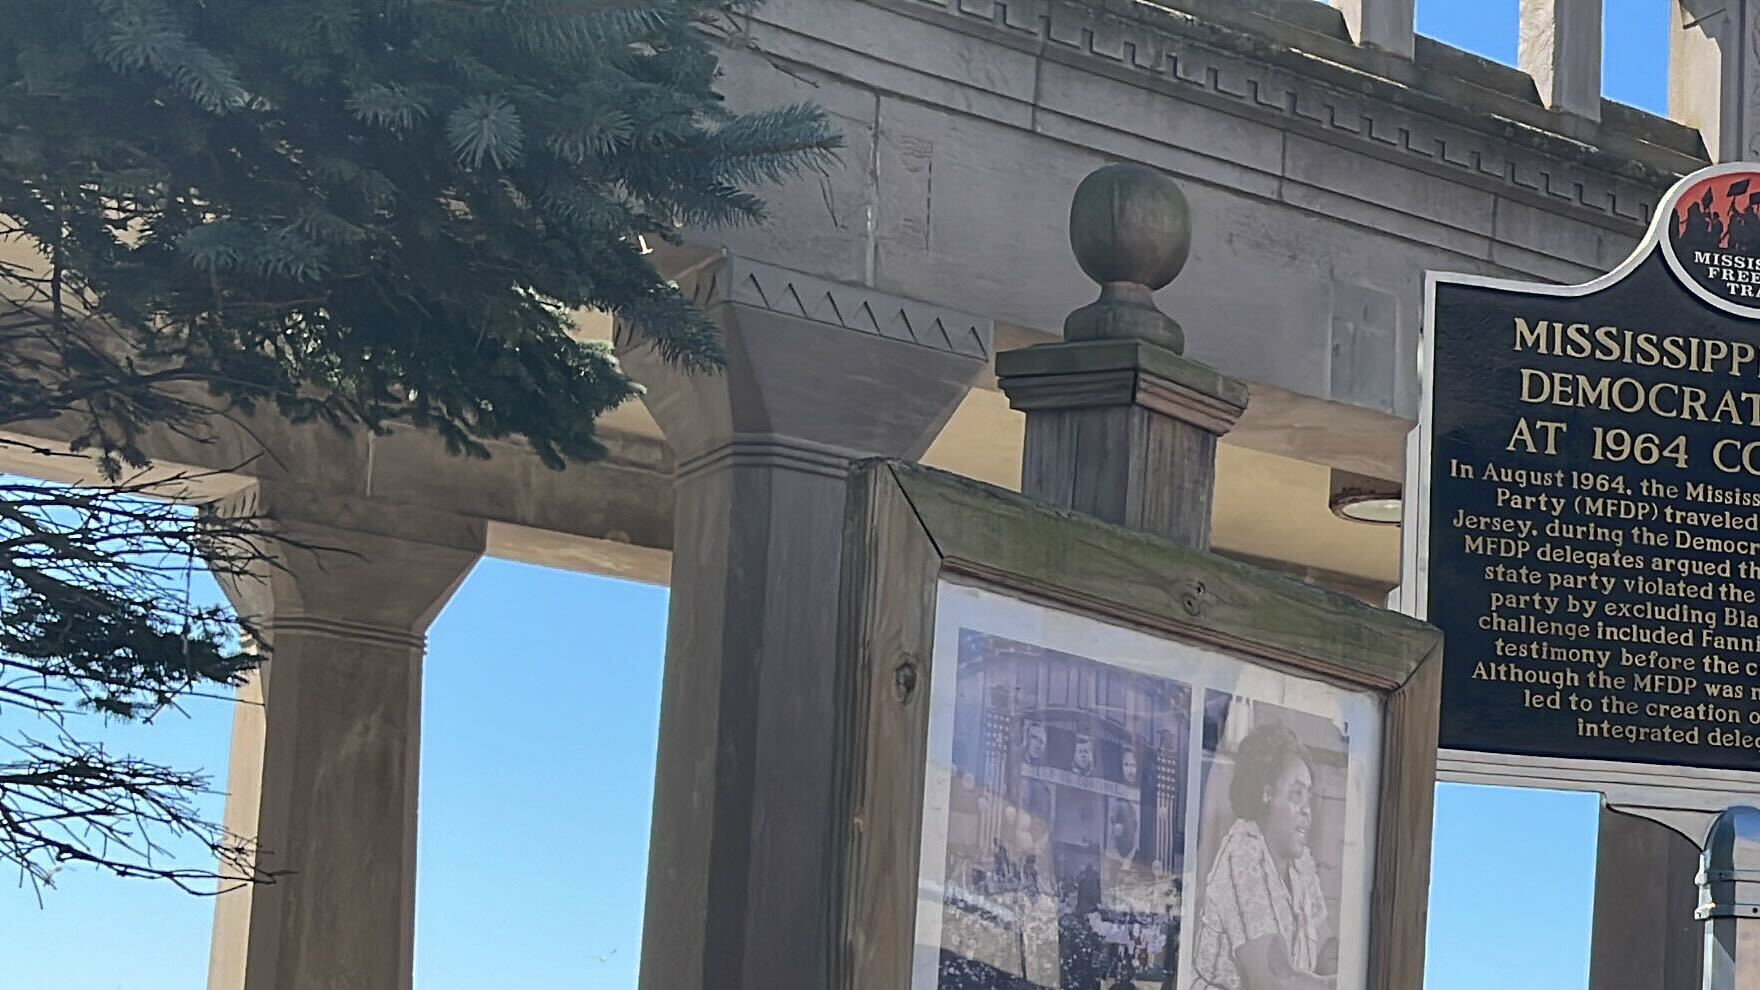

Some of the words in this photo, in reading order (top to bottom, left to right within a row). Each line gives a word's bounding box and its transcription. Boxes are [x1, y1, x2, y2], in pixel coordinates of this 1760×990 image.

[1506, 417, 1567, 454] AT
[1592, 427, 1688, 468] 1964
[1450, 459, 1474, 479] In
[1482, 462, 1564, 488] August
[1640, 478, 1678, 498] the
[1497, 488, 1566, 516] Party
[1574, 495, 1658, 521] (MFDP)
[1664, 505, 1758, 531] traveled
[1545, 518, 1623, 547] during
[1631, 526, 1669, 546] the
[1465, 534, 1530, 558] MFDP
[1536, 543, 1644, 569] delegates
[1651, 557, 1731, 578] argued
[1485, 564, 1542, 584] state
[1548, 572, 1616, 595] party
[1623, 576, 1713, 600] violated
[1718, 583, 1756, 603] the
[1478, 612, 1590, 640] challenge
[1597, 621, 1694, 646] included
[1491, 592, 1559, 614] party
[1567, 594, 1597, 618] by
[1604, 601, 1716, 629] excluding
[1494, 638, 1611, 668] testimony
[1620, 647, 1695, 671] before
[1702, 654, 1740, 674] the
[1471, 661, 1579, 690] Although
[1586, 670, 1626, 690] the
[1633, 673, 1697, 695] MFDP
[1704, 683, 1743, 698] was
[1524, 689, 1560, 710] led
[1568, 692, 1592, 712] to
[1600, 695, 1638, 714] the
[1646, 703, 1741, 723] creation
[1578, 718, 1699, 744] integrated
